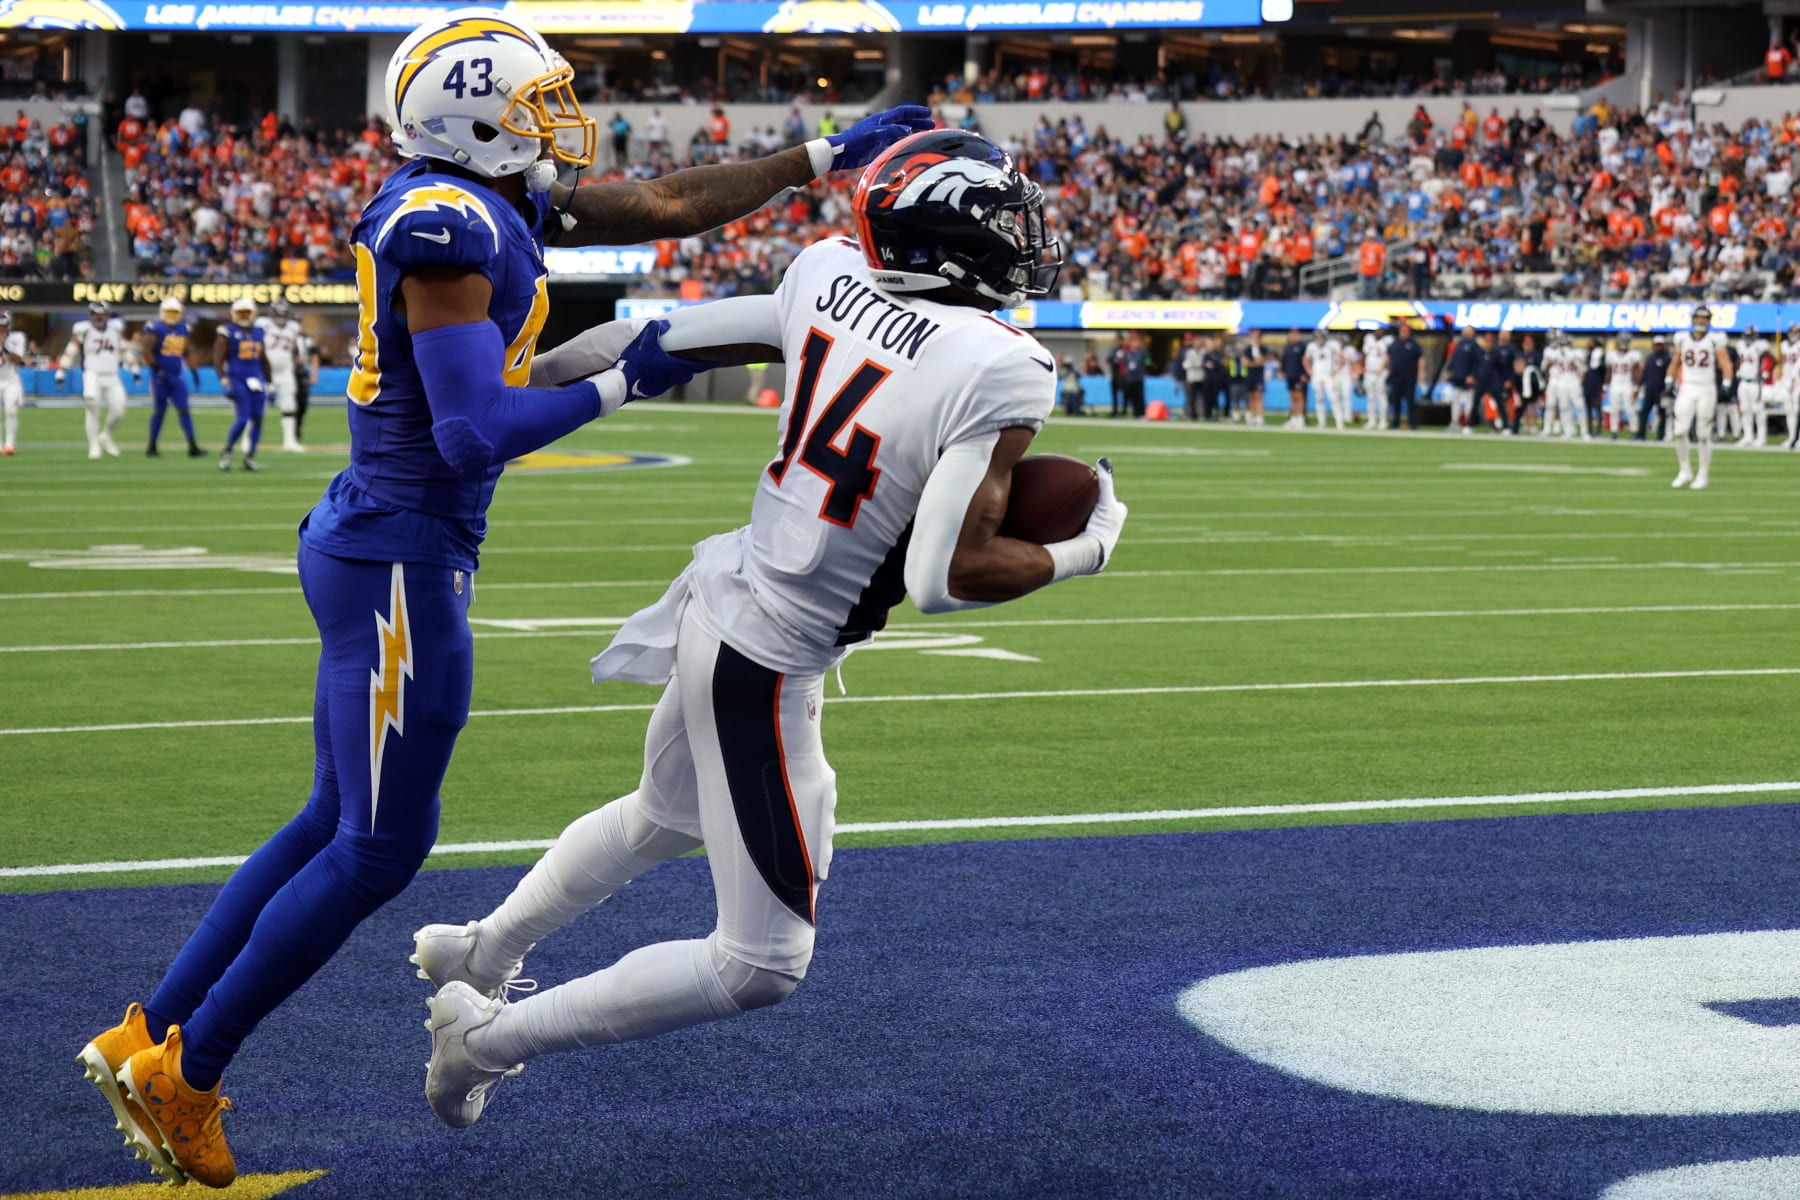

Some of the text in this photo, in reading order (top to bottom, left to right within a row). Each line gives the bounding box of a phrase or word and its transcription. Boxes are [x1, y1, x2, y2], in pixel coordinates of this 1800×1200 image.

[145, 5, 196, 25] LOS
[197, 5, 314, 29] ANGELES
[918, 3, 1204, 29] LOS ANGELES CHARGERS
[443, 57, 493, 99] 43
[881, 247, 895, 261] 14
[73, 283, 125, 302] PLAY
[130, 284, 189, 302] YOUR
[191, 283, 283, 303] PERFECT
[816, 274, 940, 361] SUTTON
[1455, 304, 1738, 332] LOS ANGELES CHARGRS
[1684, 349, 1709, 368] 82
[767, 325, 893, 530] 14
